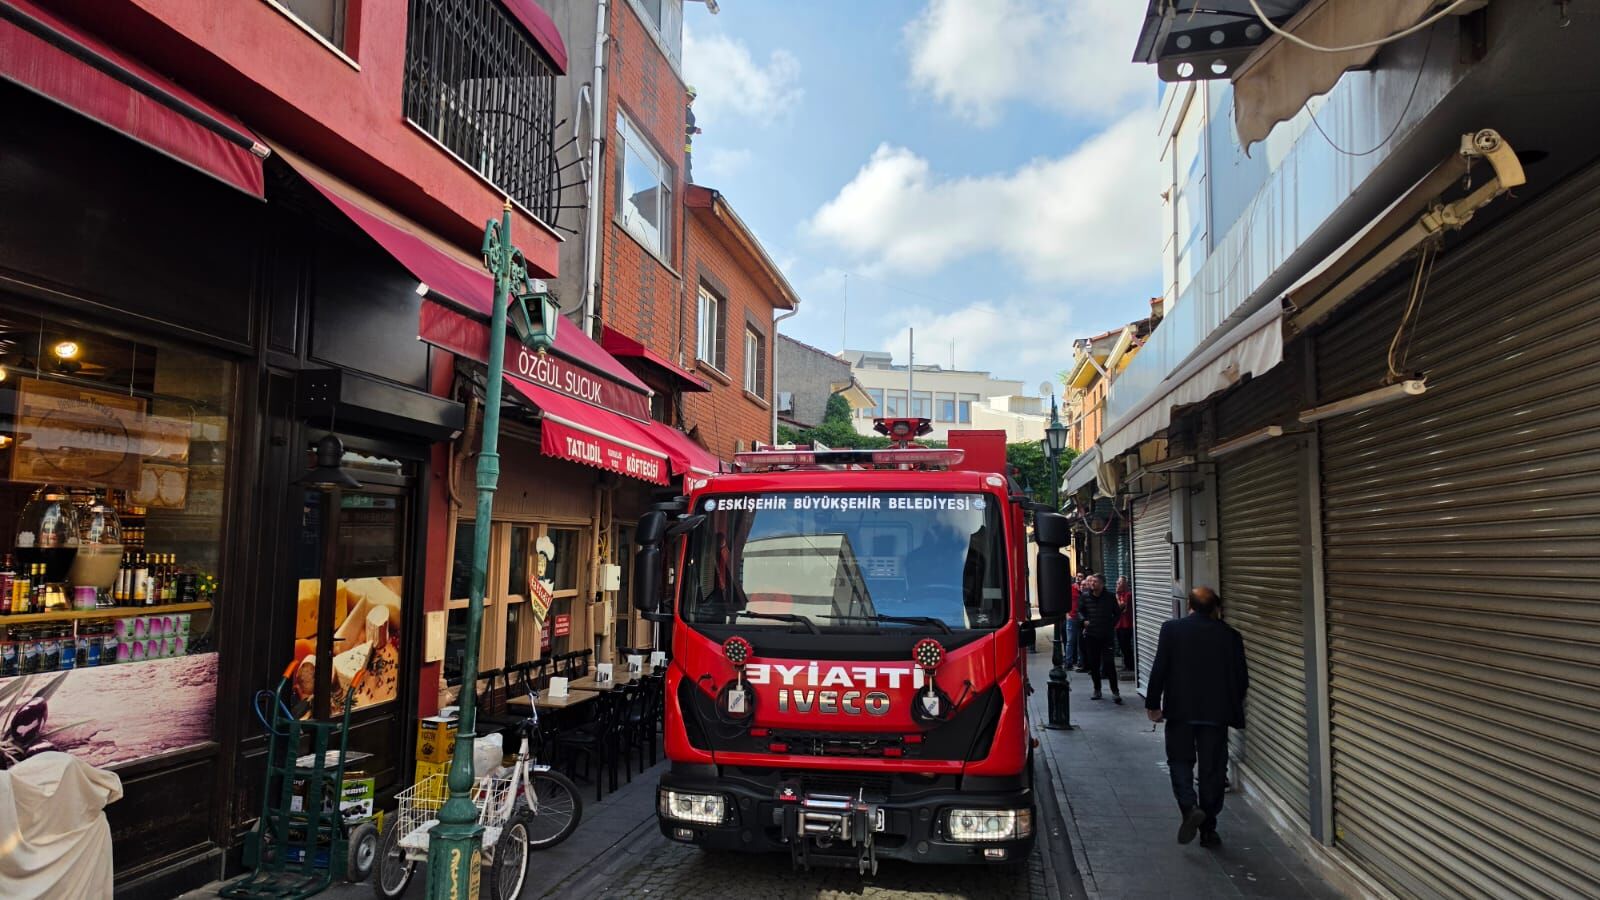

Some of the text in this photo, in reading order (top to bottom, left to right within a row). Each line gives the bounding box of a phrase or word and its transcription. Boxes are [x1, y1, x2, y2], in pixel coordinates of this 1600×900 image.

[518, 346, 602, 403] ÖZGÜL SUCUK
[566, 436, 602, 463] TATLIDİL
[626, 452, 659, 479] KÖFTECİSİ
[717, 496, 969, 512] ESKİŞEHİR BÜYÜKŞEHİR BELEDİYESİ
[778, 689, 891, 716] IVECO
